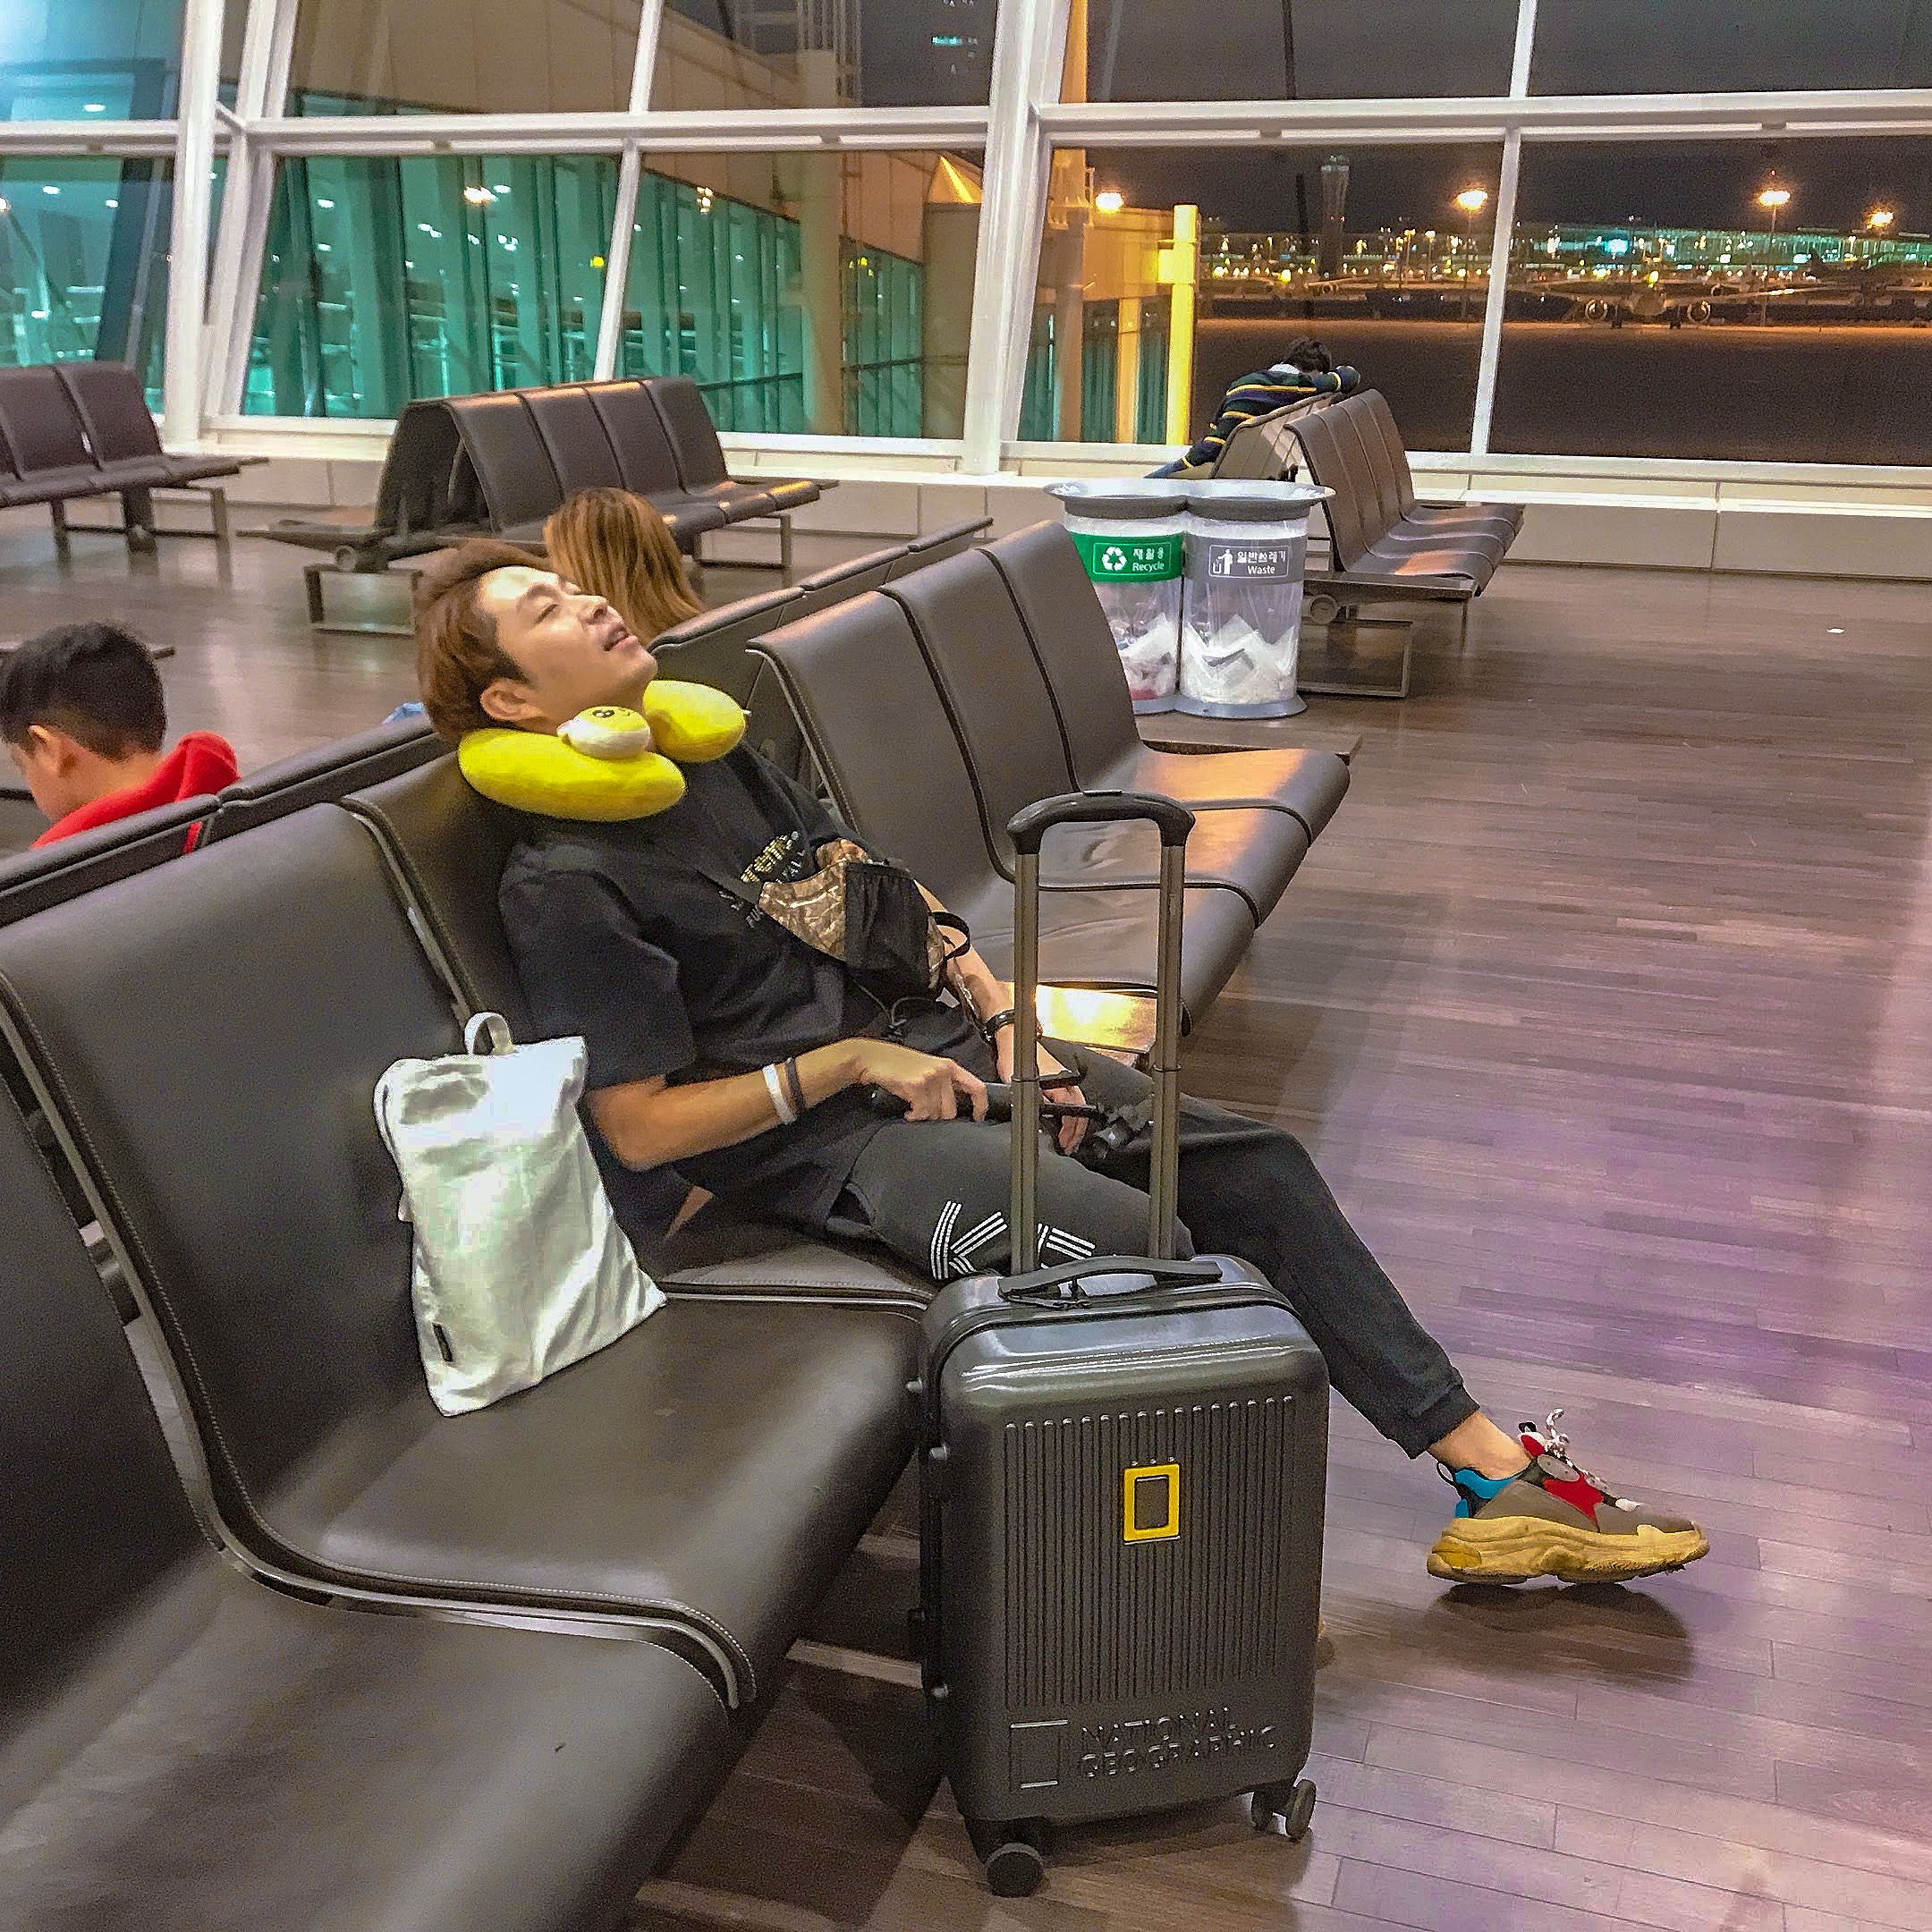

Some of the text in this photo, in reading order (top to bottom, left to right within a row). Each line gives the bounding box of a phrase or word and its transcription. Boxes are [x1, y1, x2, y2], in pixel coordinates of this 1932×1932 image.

[1236, 550, 1286, 564] 일반쓰레기
[1131, 561, 1165, 572] Recycle
[1247, 564, 1275, 575] Waste
[1081, 1706, 1236, 1750] NATIONAL
[1080, 1724, 1275, 1779] GEOGRAPHIC
